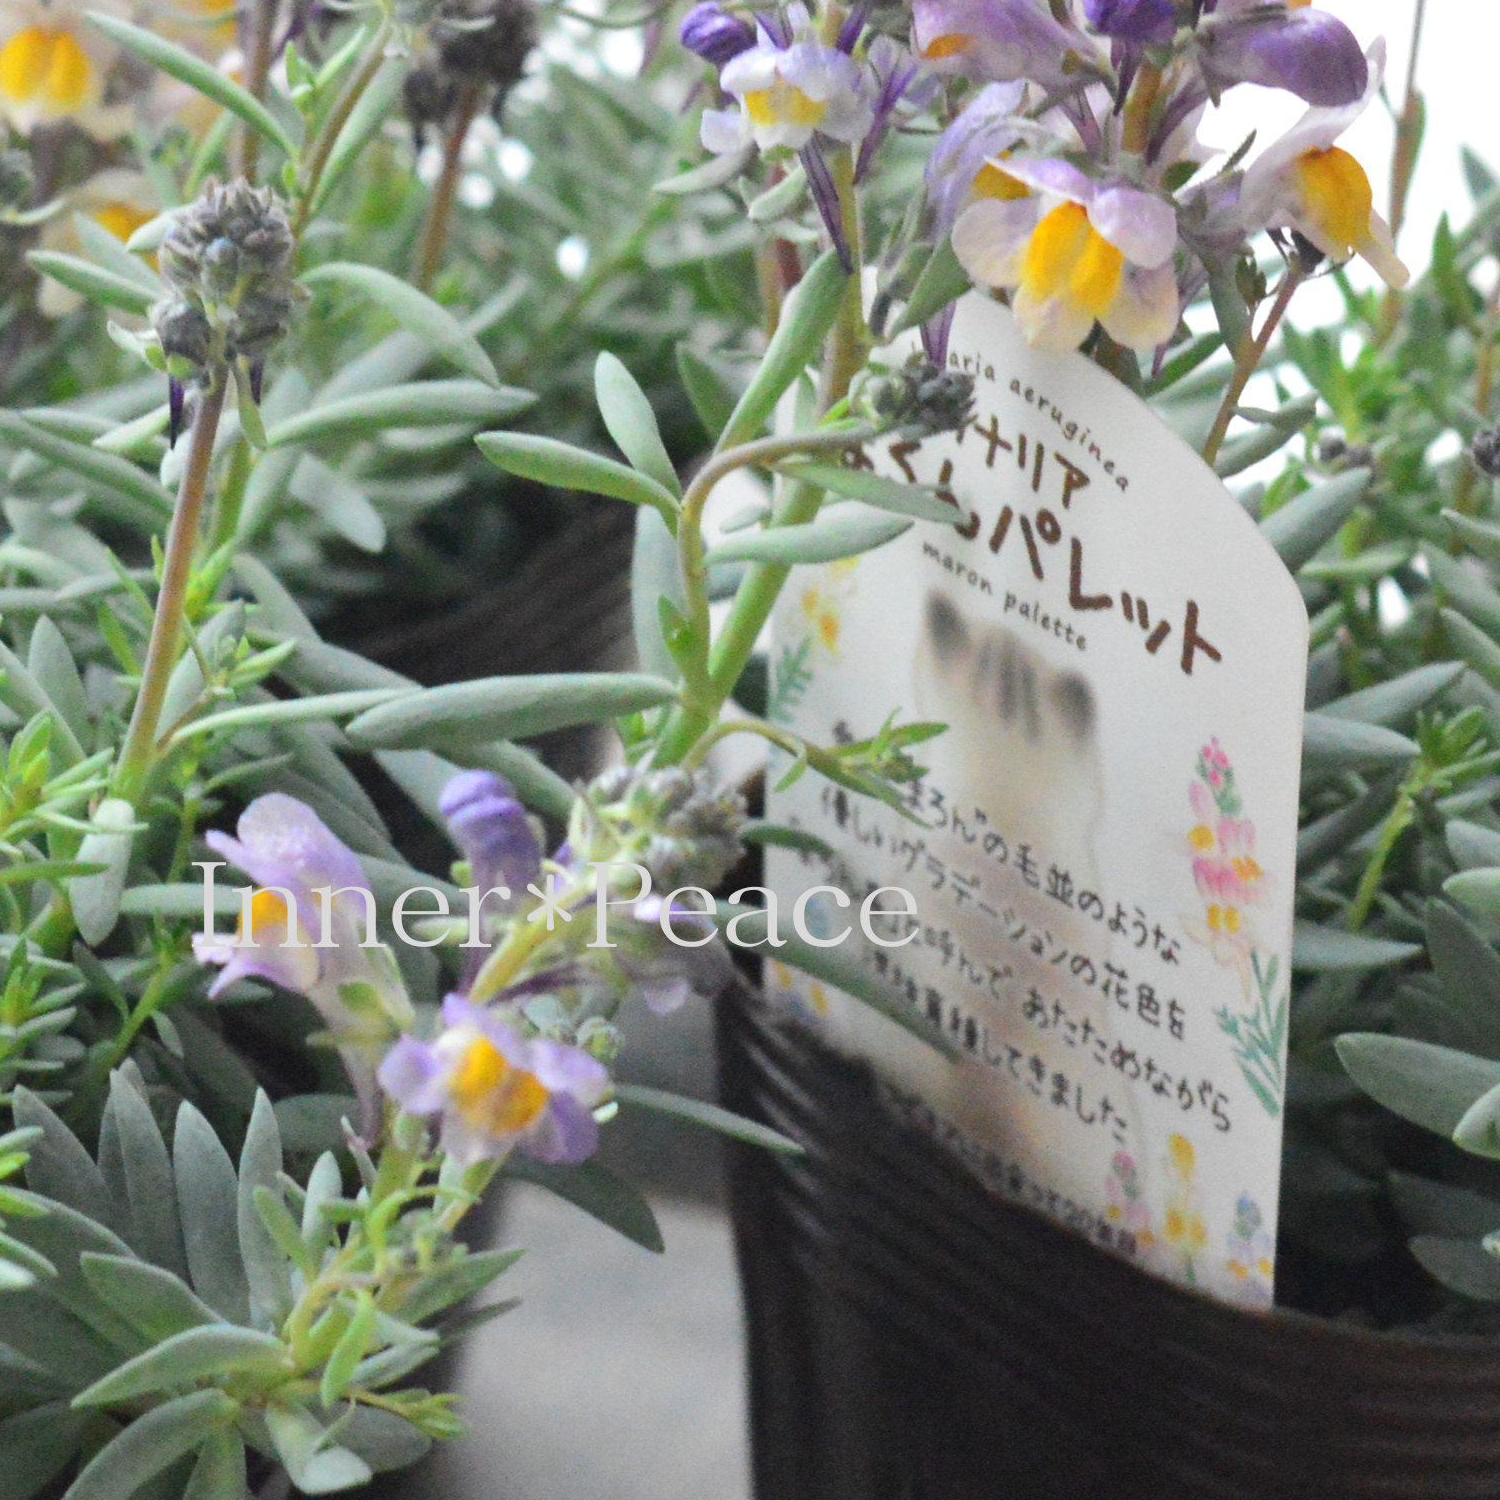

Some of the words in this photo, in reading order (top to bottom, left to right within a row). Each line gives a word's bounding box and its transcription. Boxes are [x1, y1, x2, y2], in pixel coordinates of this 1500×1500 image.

[955, 413, 1091, 510] ナリア
[1010, 377, 1129, 493] aeruginea
[921, 540, 993, 596] maron
[1004, 590, 1088, 653] palette
[1021, 987, 1232, 1133] あたためながら
